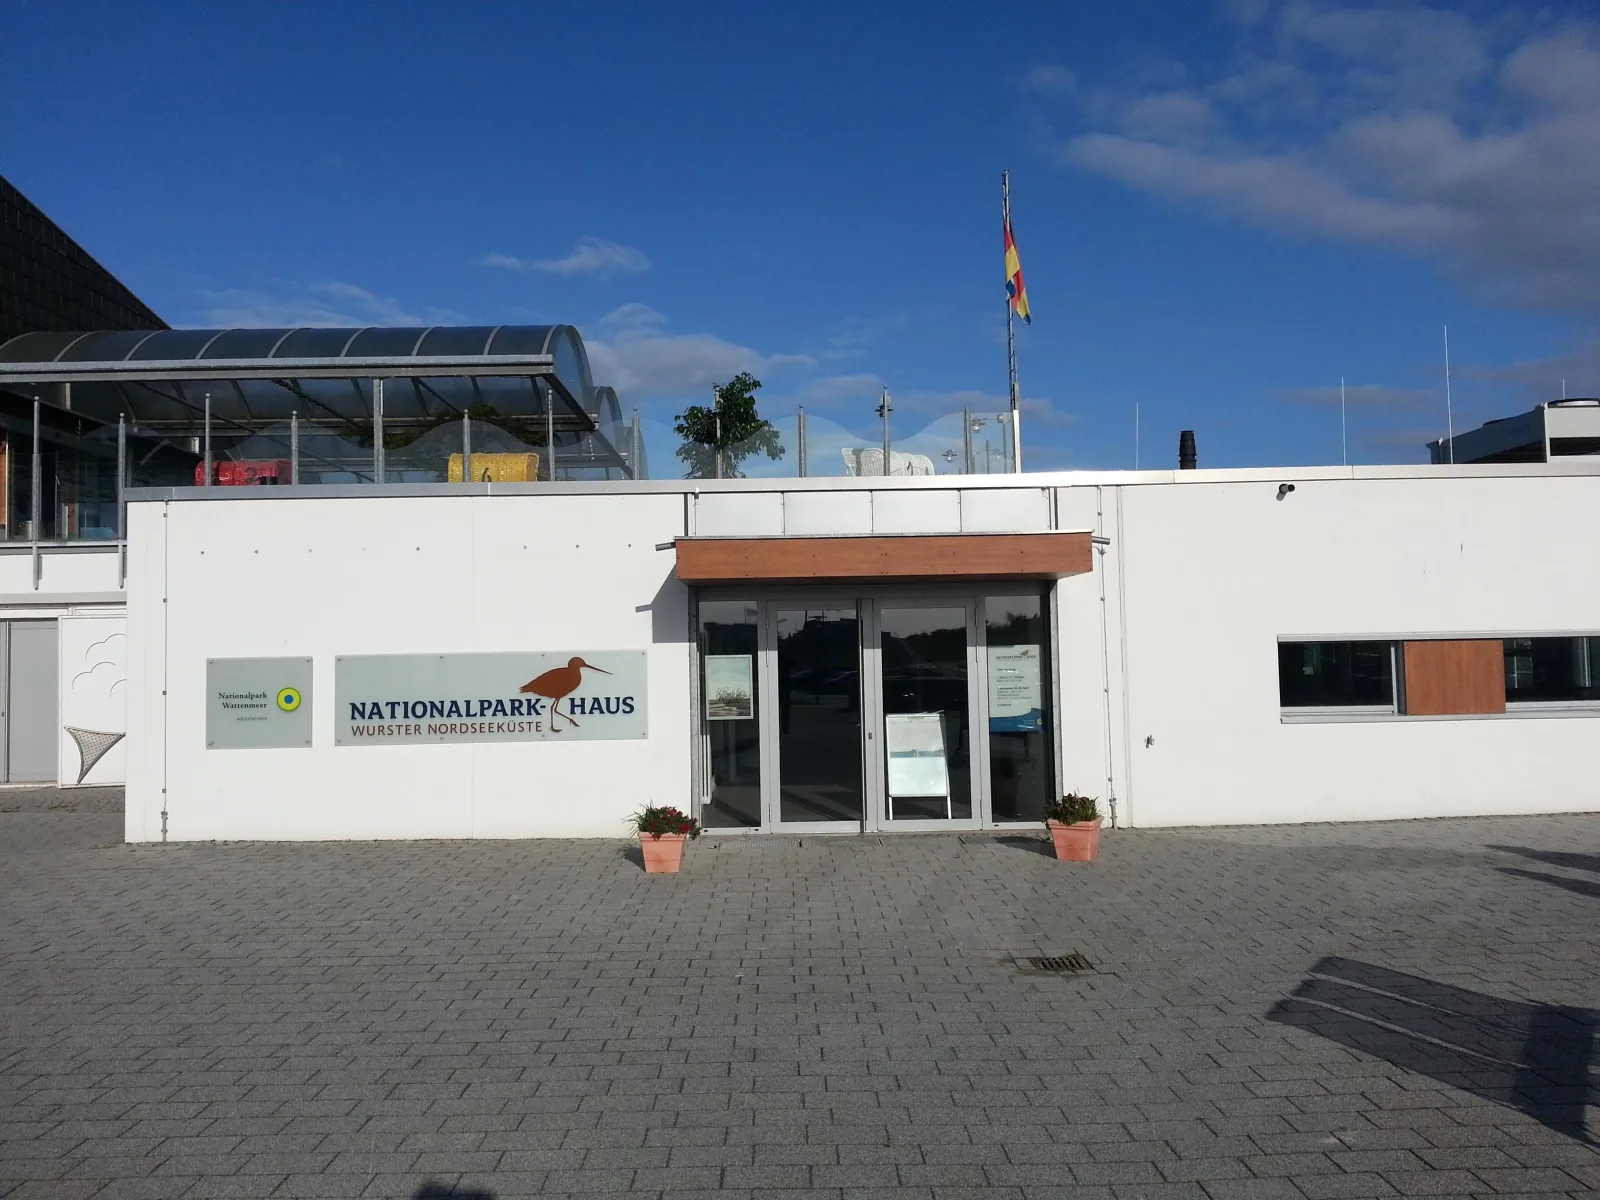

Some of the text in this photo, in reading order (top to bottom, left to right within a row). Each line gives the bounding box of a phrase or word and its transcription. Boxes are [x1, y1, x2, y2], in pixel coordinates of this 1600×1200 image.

[218, 692, 267, 700] Nationalpark
[349, 696, 635, 720] NATIONALPARK- HAUS
[351, 720, 542, 737] WURSTER NORDSEEKÜSTE
